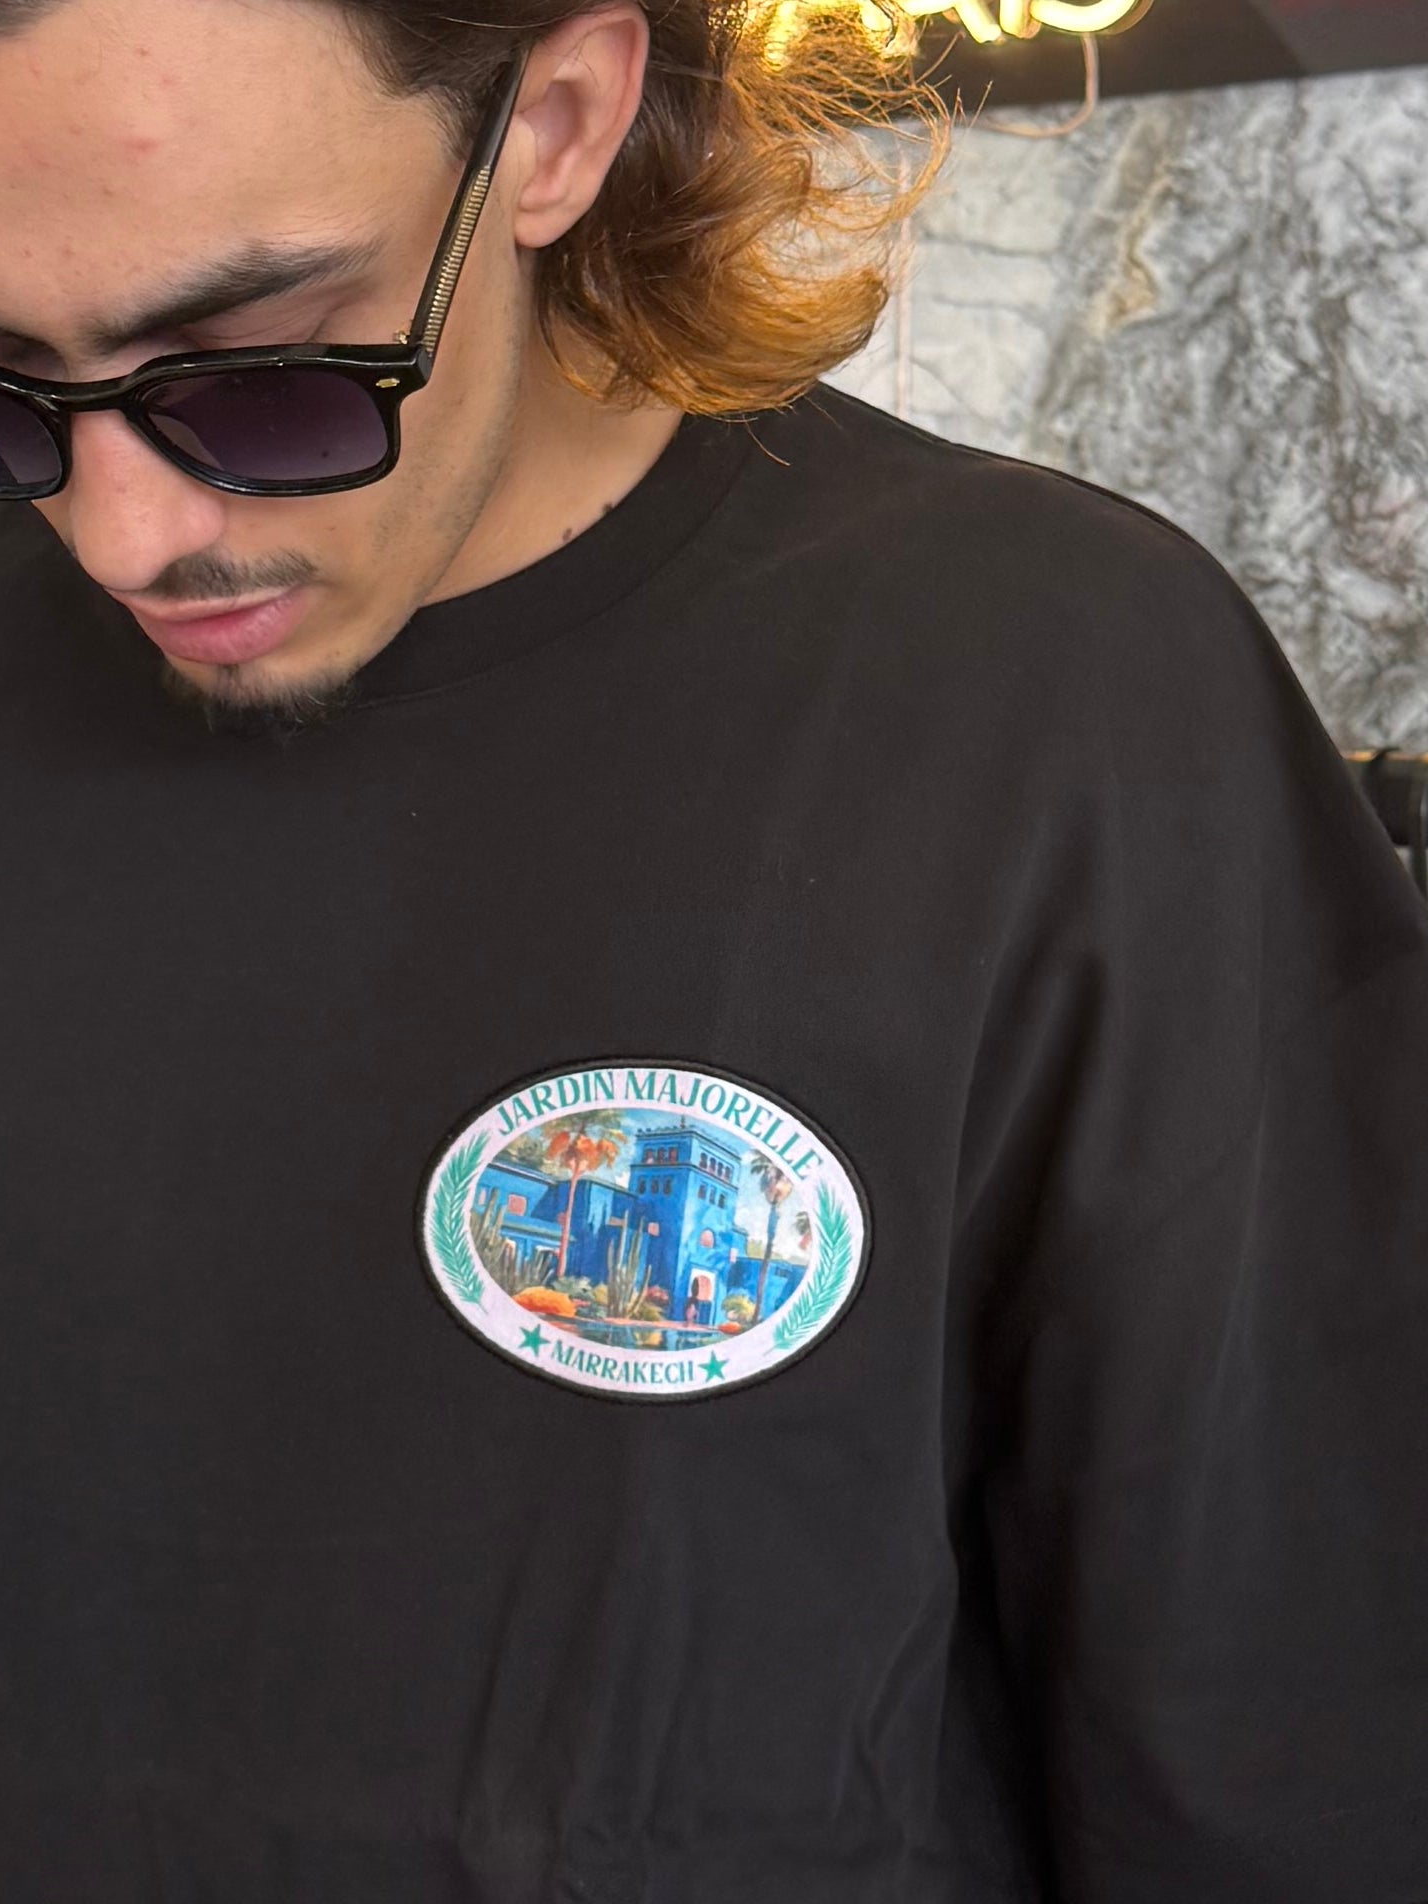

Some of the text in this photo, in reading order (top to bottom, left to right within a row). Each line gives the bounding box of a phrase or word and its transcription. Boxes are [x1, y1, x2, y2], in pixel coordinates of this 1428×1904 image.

[496, 1069, 824, 1181] JARDIN MAJORELLE
[551, 1339, 694, 1385] MARRAKECH
